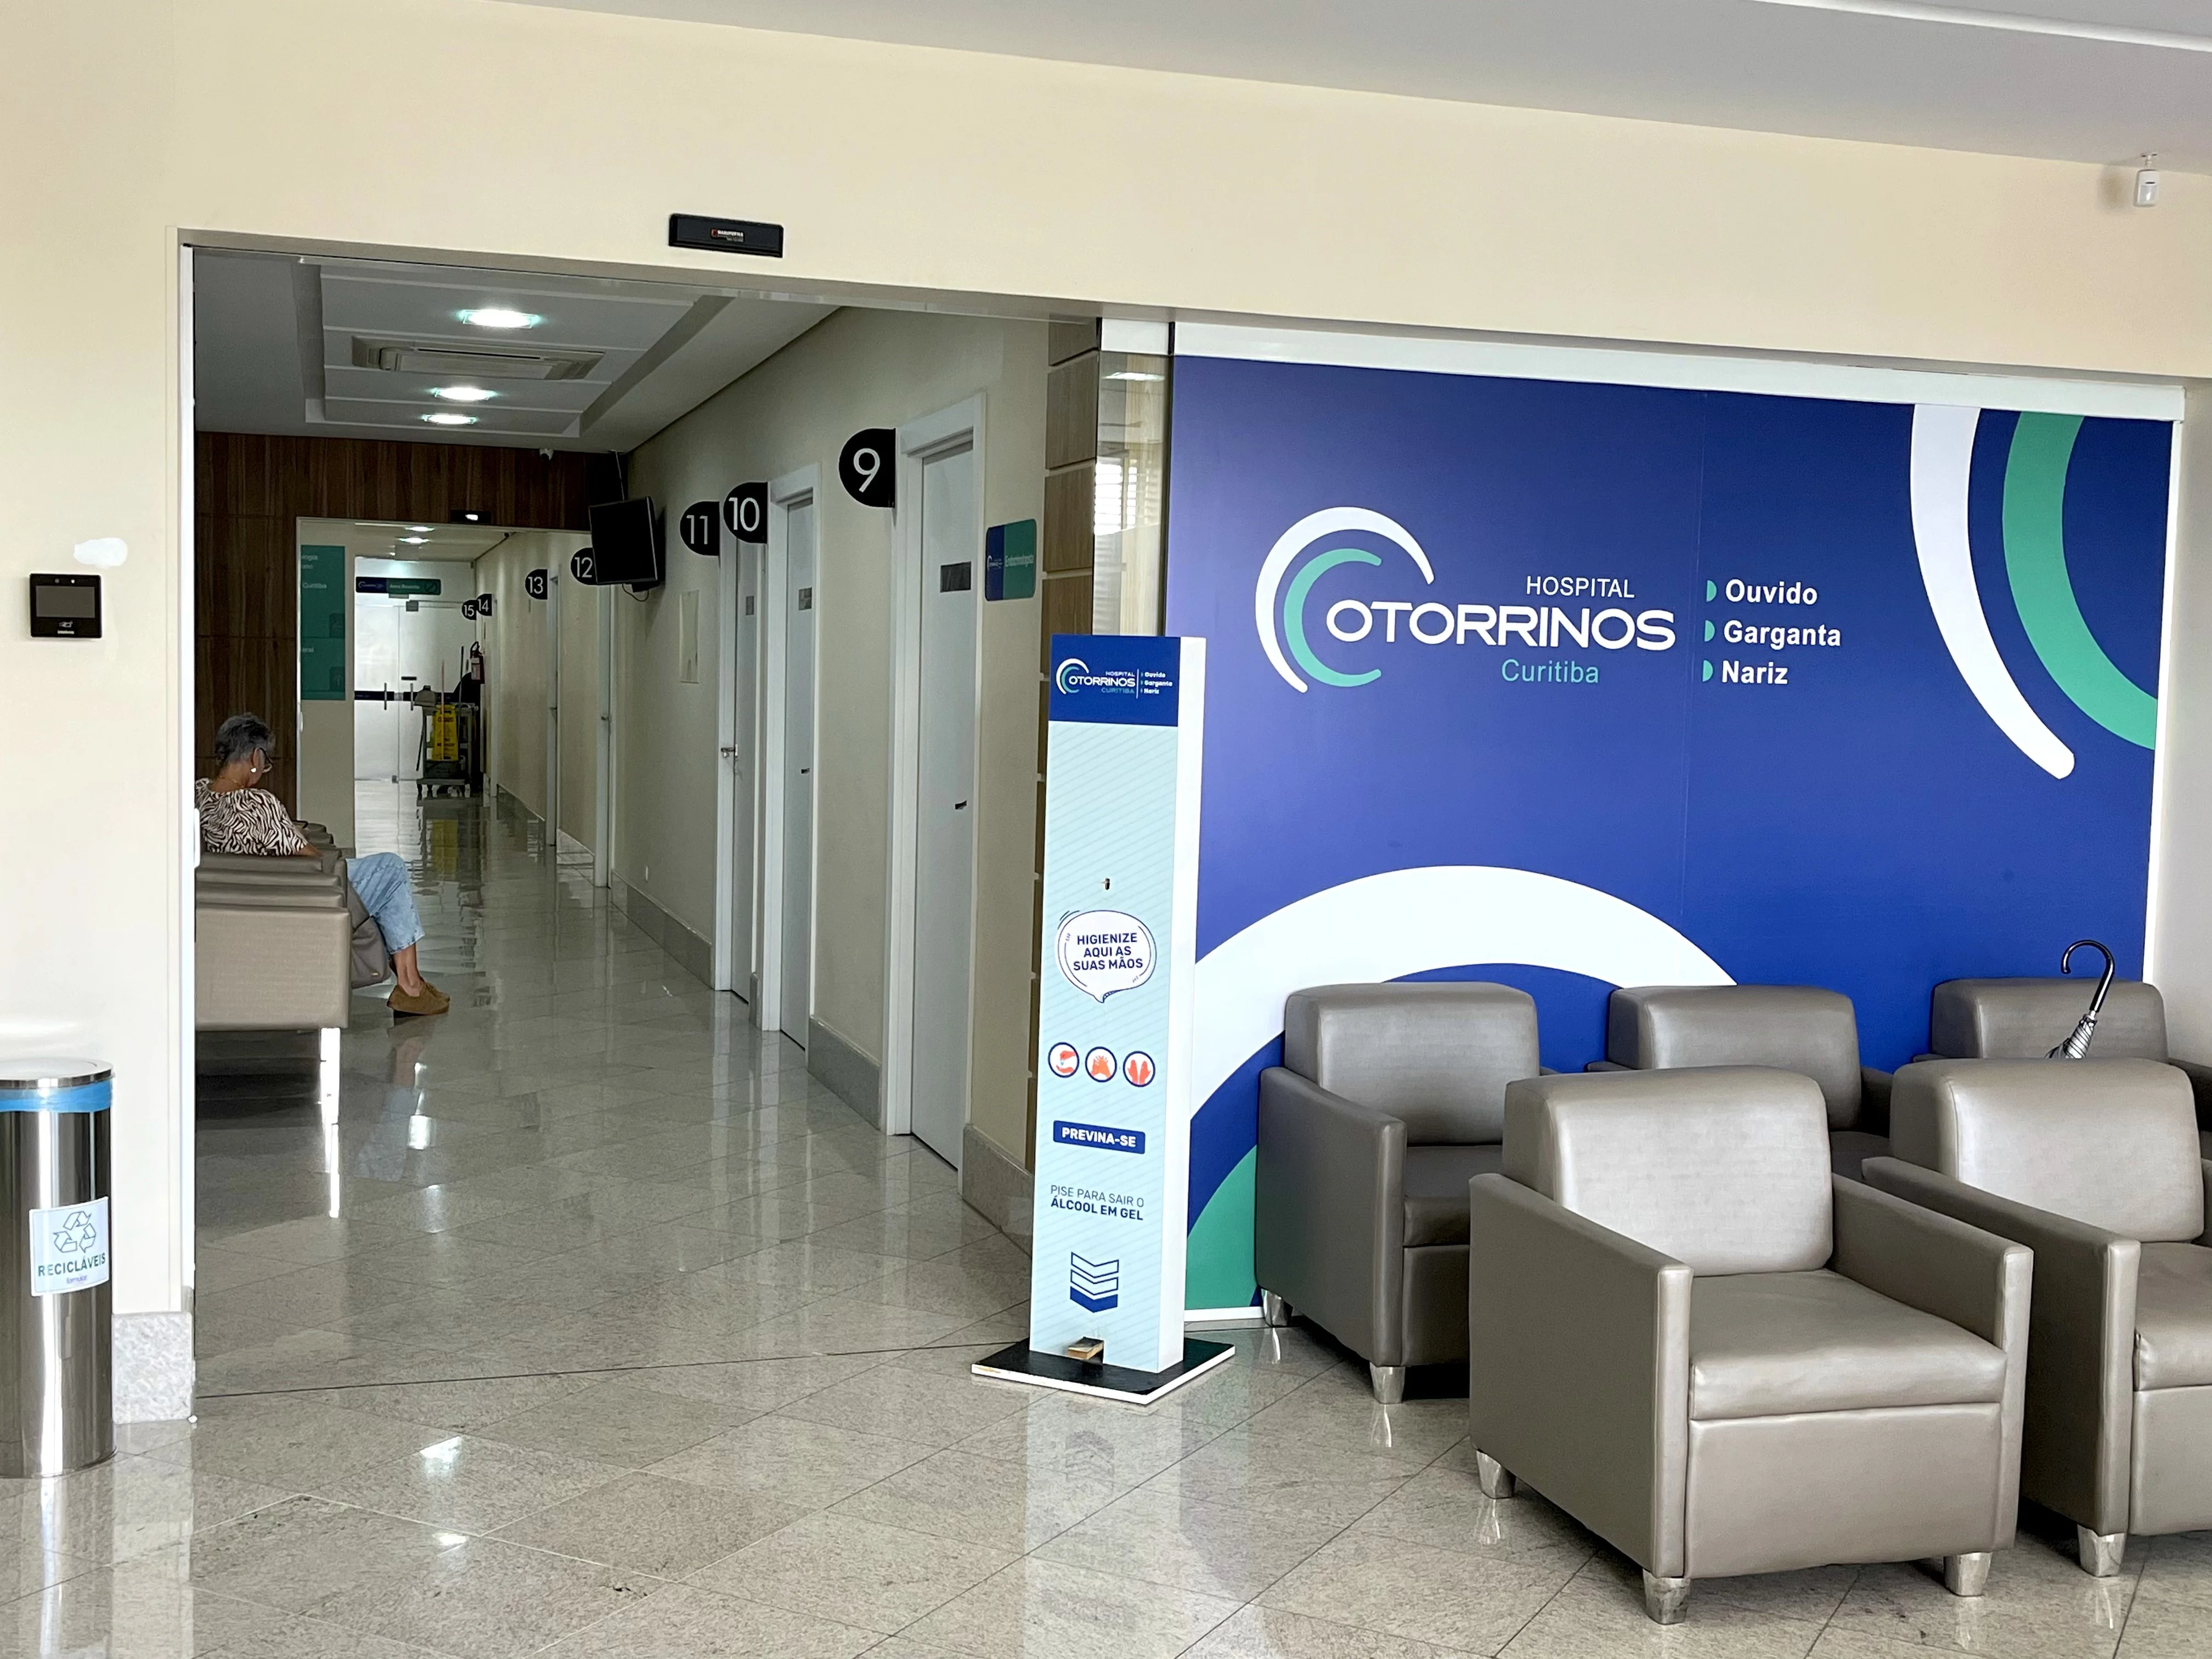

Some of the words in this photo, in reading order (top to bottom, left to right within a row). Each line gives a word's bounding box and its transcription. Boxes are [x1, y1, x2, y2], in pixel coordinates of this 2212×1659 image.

[853, 447, 881, 493] 9
[727, 496, 760, 532] 10
[686, 515, 709, 544] 11
[574, 557, 593, 578] 12
[527, 576, 544, 594] 13
[1526, 575, 1635, 598] HOSPITAL
[1725, 579, 1818, 606] Ouvido
[464, 605, 475, 617] 15
[477, 599, 489, 612] 14
[1325, 599, 1677, 651] OTORRINOS
[1723, 620, 1841, 650] Garganta
[1068, 675, 1136, 687] OTORRINOS
[1501, 659, 1599, 684] Curitiba
[1721, 660, 1788, 685] Nariz
[1077, 933, 1138, 945] HIGIENIZE
[1073, 960, 1105, 971] SUAS
[1108, 956, 1143, 970] MÃOS
[1084, 946, 1113, 958] AQUI
[1115, 946, 1132, 956] AS
[1061, 1127, 1137, 1148] PREVINA-SE
[1050, 1184, 1074, 1198] PISE
[1077, 1188, 1106, 1202] PARA
[1108, 1193, 1134, 1206] SAIR
[1136, 1197, 1144, 1207] O
[1051, 1195, 1098, 1214] ÁLCOOL
[1100, 1205, 1118, 1217] EM
[1120, 1207, 1144, 1221] GEL
[38, 1252, 106, 1277] RECICLÁVEIS
